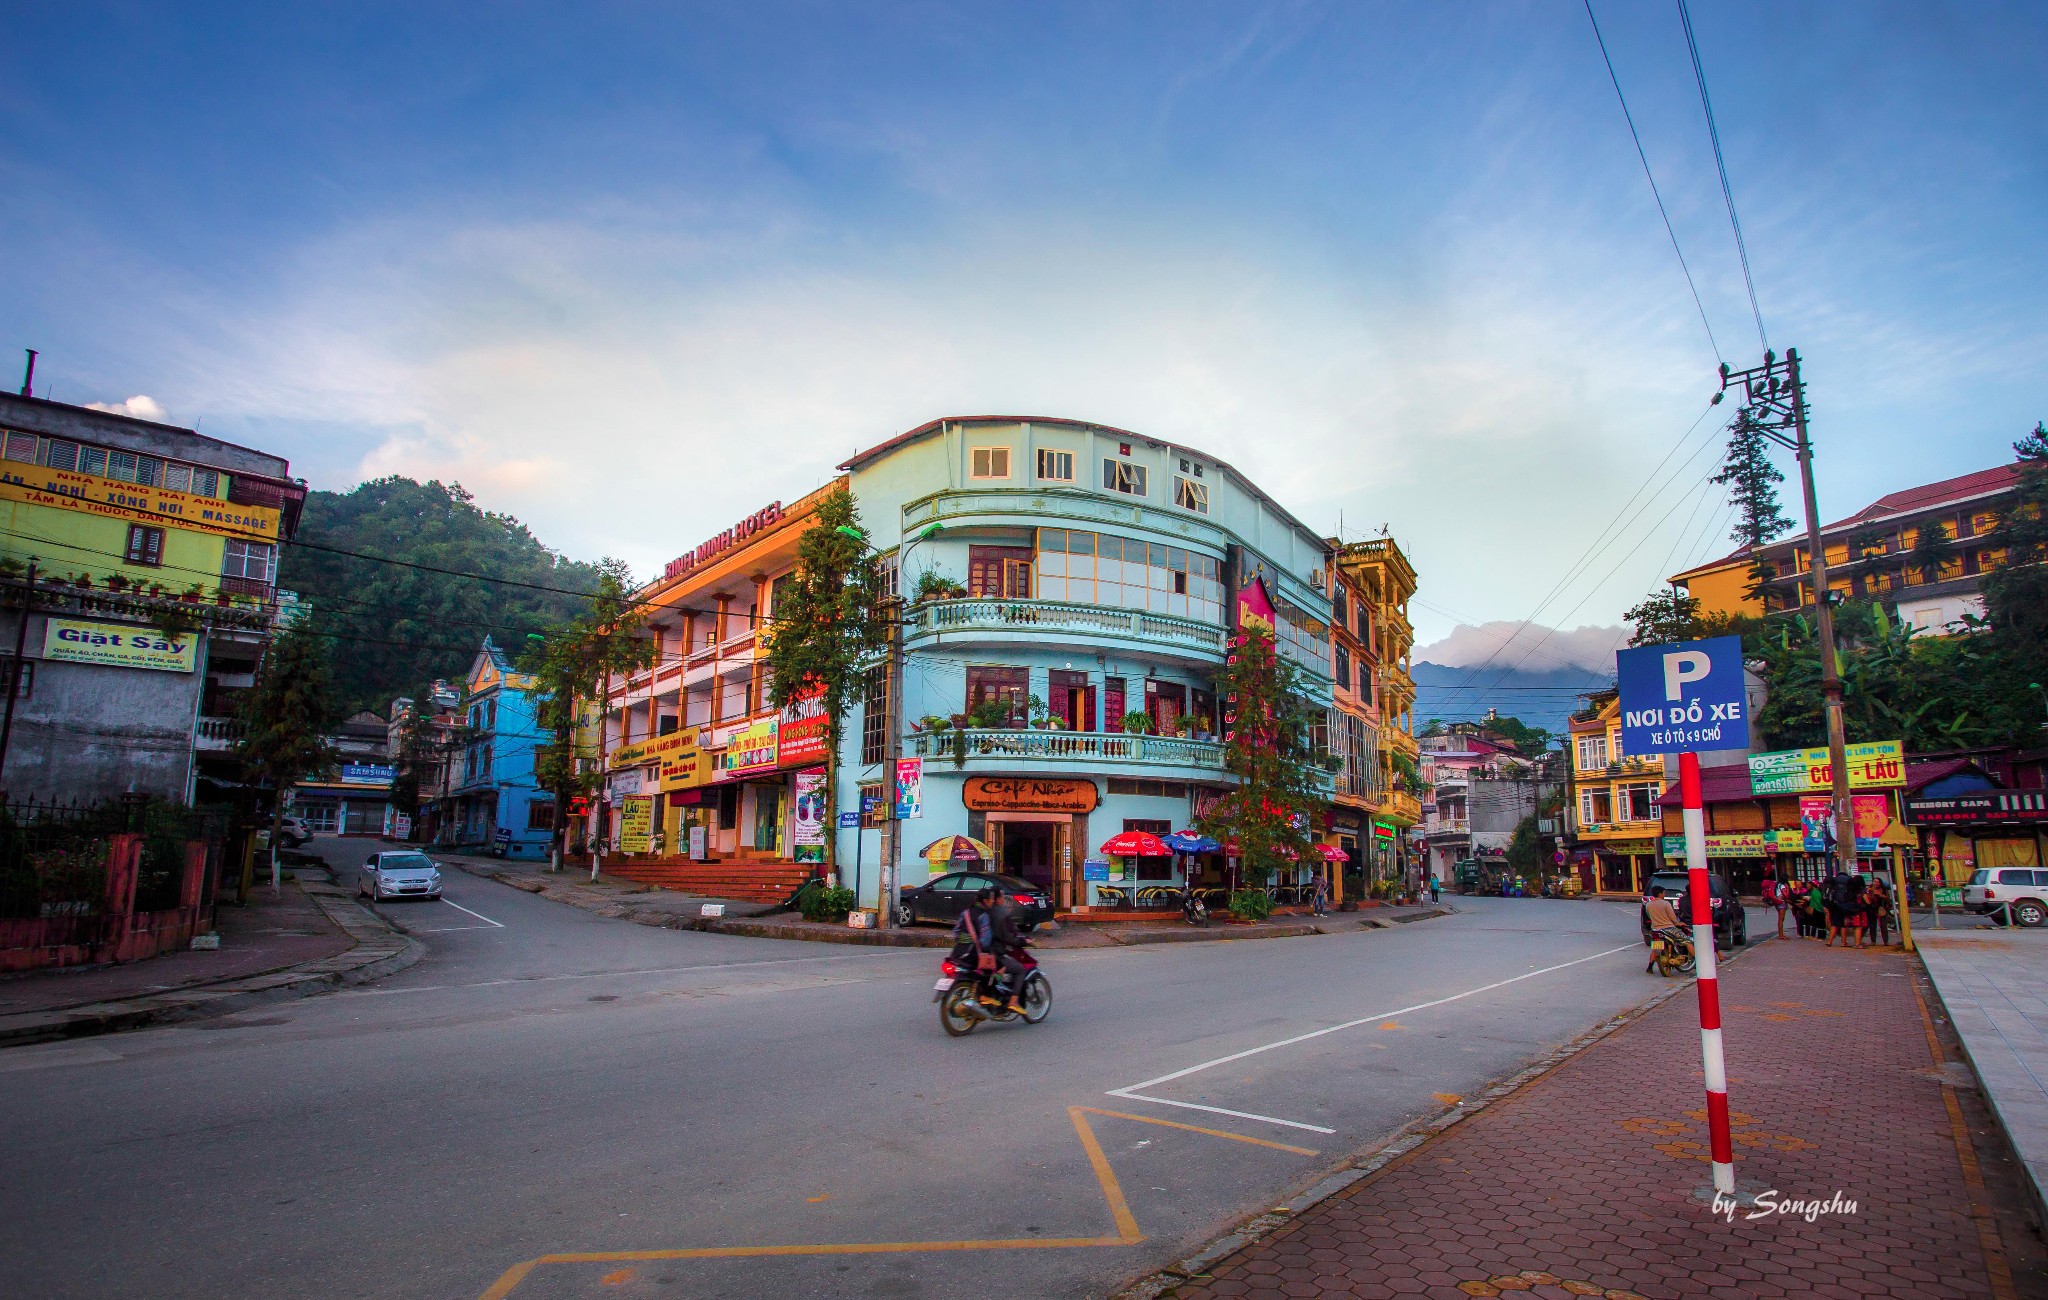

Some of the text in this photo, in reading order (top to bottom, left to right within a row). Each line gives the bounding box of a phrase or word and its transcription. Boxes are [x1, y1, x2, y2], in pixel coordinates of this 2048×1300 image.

[103, 481, 150, 495] HÀNG
[193, 498, 225, 508] ANH
[107, 492, 148, 508] XÔNG
[202, 509, 267, 529] MASSAGE
[695, 528, 733, 563] MINH
[734, 500, 783, 542] HOTEL
[57, 628, 123, 648] Giặt
[1663, 650, 1712, 701] P
[1625, 698, 1741, 728] NƠI ĐỖ XE
[1651, 732, 1663, 745] XE
[1673, 728, 1685, 743] TÔ
[350, 767, 392, 776] SAMSUNG
[980, 780, 1026, 800] Café
[1909, 801, 1956, 809] MEMORY
